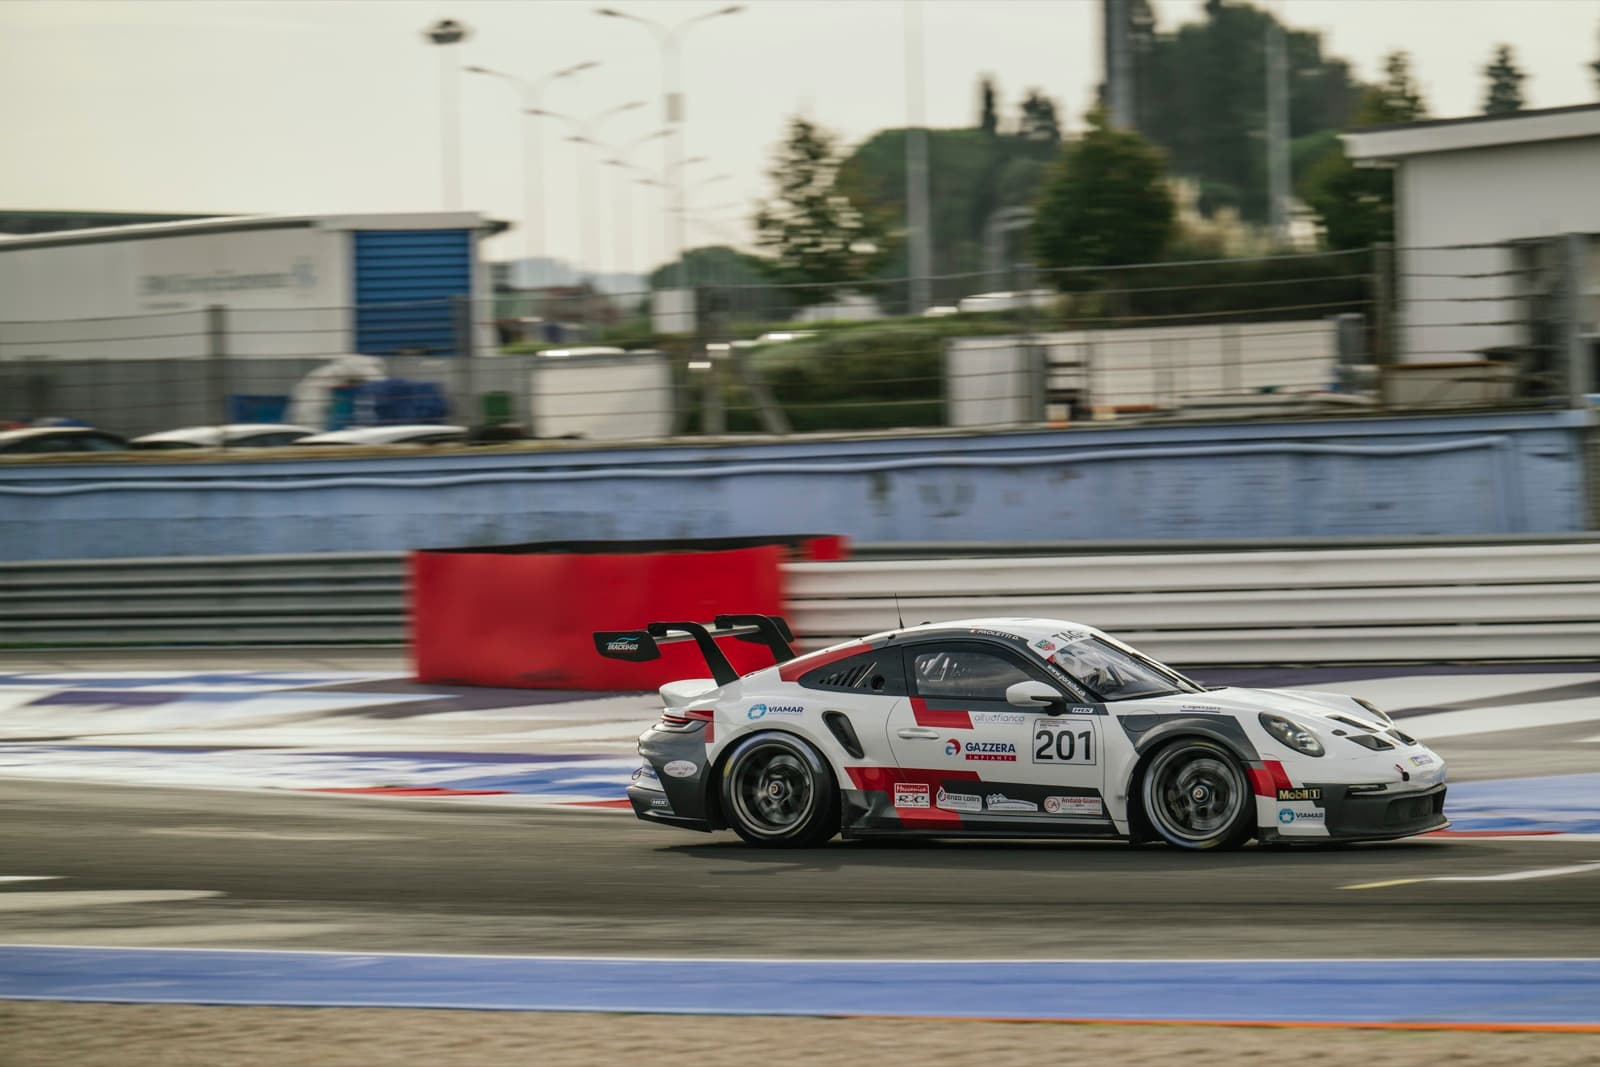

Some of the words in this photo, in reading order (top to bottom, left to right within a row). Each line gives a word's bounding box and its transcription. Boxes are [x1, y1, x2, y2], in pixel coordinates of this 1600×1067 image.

[965, 742, 1016, 753] GAZZERA
[1035, 730, 1092, 761] 201
[1279, 789, 1309, 800] Mobil
